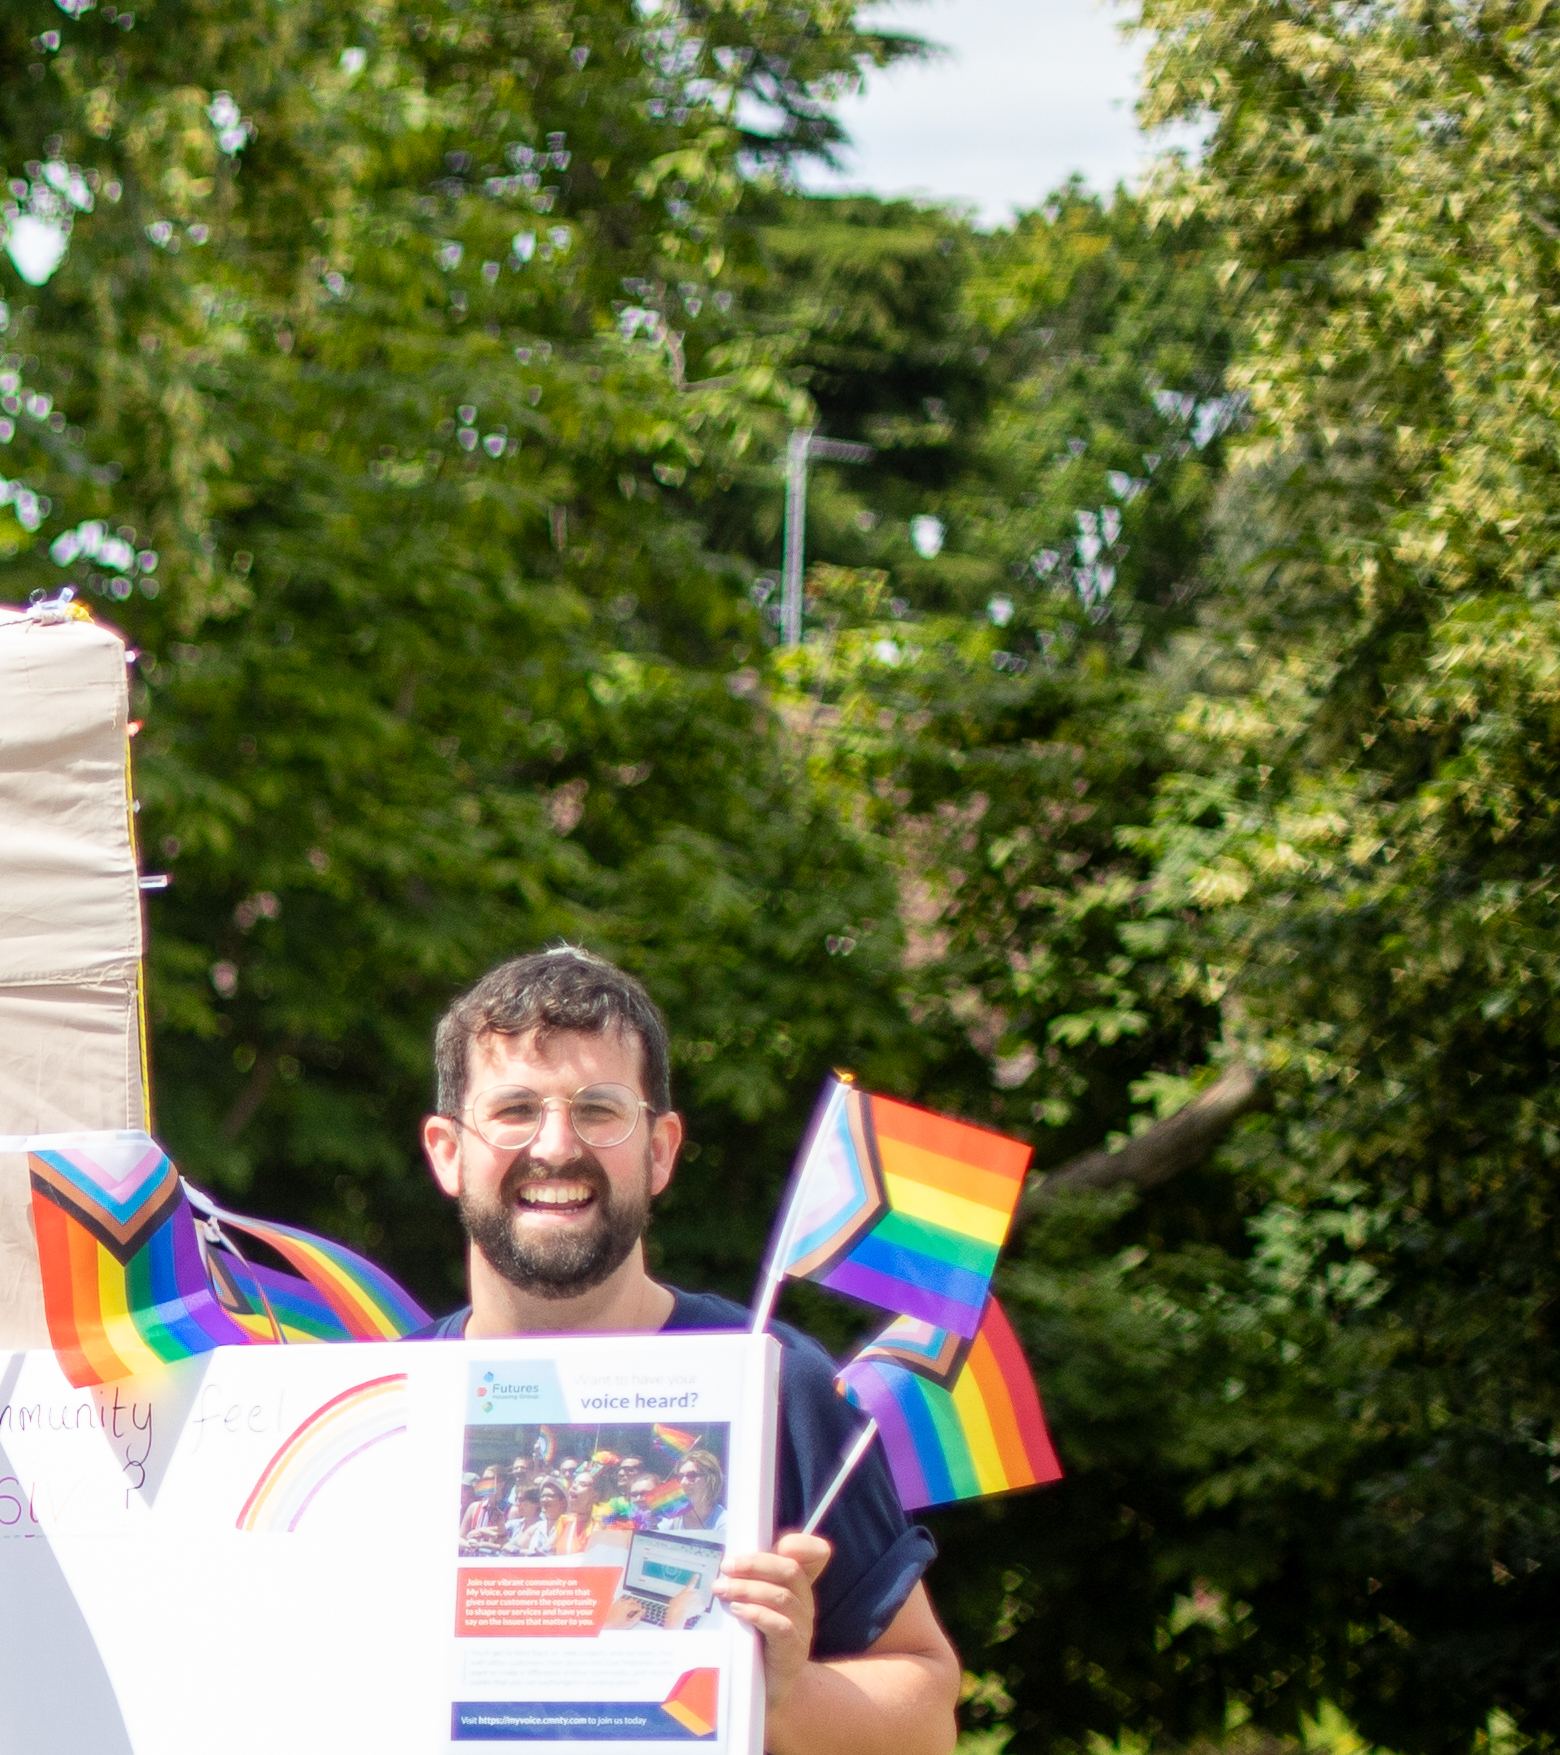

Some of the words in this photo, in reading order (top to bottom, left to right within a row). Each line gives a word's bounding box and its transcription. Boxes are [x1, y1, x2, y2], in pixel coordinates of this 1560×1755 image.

[574, 1374, 611, 1386] Want
[615, 1375, 628, 1386] to
[632, 1374, 664, 1385] have
[667, 1375, 698, 1388] your
[492, 1383, 539, 1394] Futures
[581, 1393, 630, 1409] voice
[635, 1391, 699, 1409] heard?
[191, 1384, 284, 1455] feel
[461, 1716, 477, 1724] Visit
[597, 1716, 612, 1726] join
[624, 1716, 647, 1726] today
